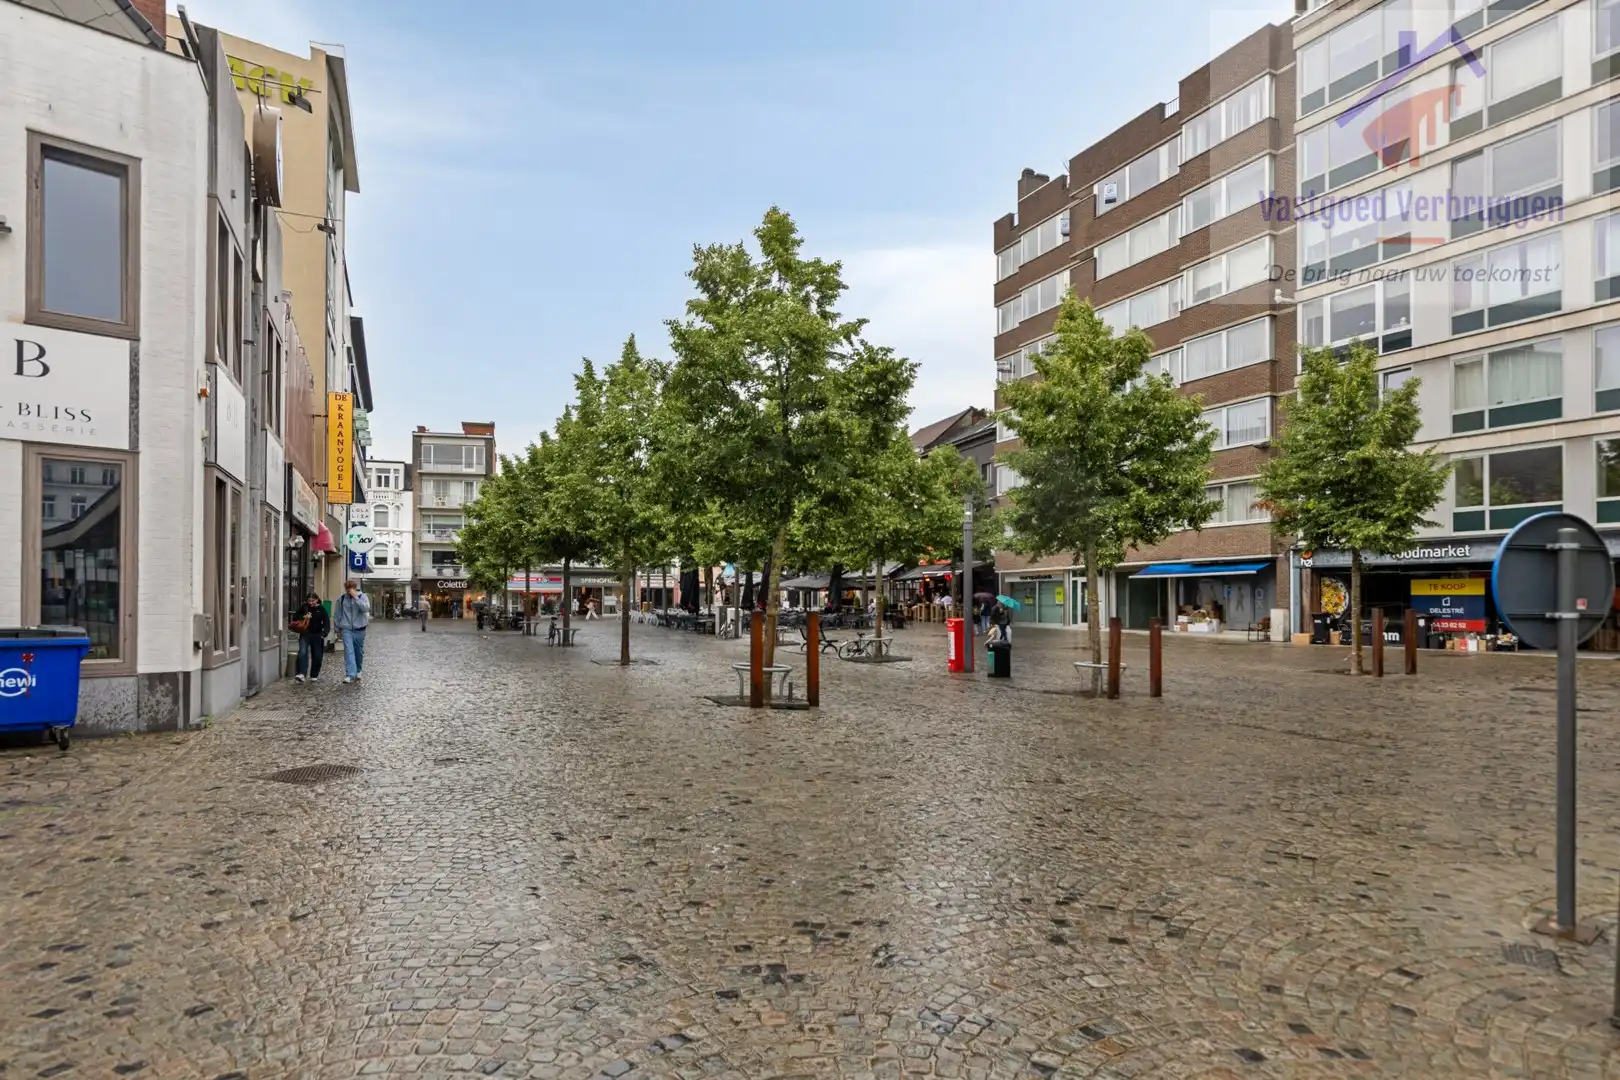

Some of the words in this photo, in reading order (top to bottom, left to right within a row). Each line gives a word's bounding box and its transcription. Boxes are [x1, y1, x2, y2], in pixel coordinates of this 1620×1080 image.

[13, 338, 51, 379] B
[335, 394, 347, 402] DE
[17, 401, 93, 424] BLISS
[336, 403, 344, 490] KRAANVOGEL
[437, 580, 468, 589] Colette
[1428, 583, 1439, 592] TE
[1440, 582, 1466, 591] KOOP
